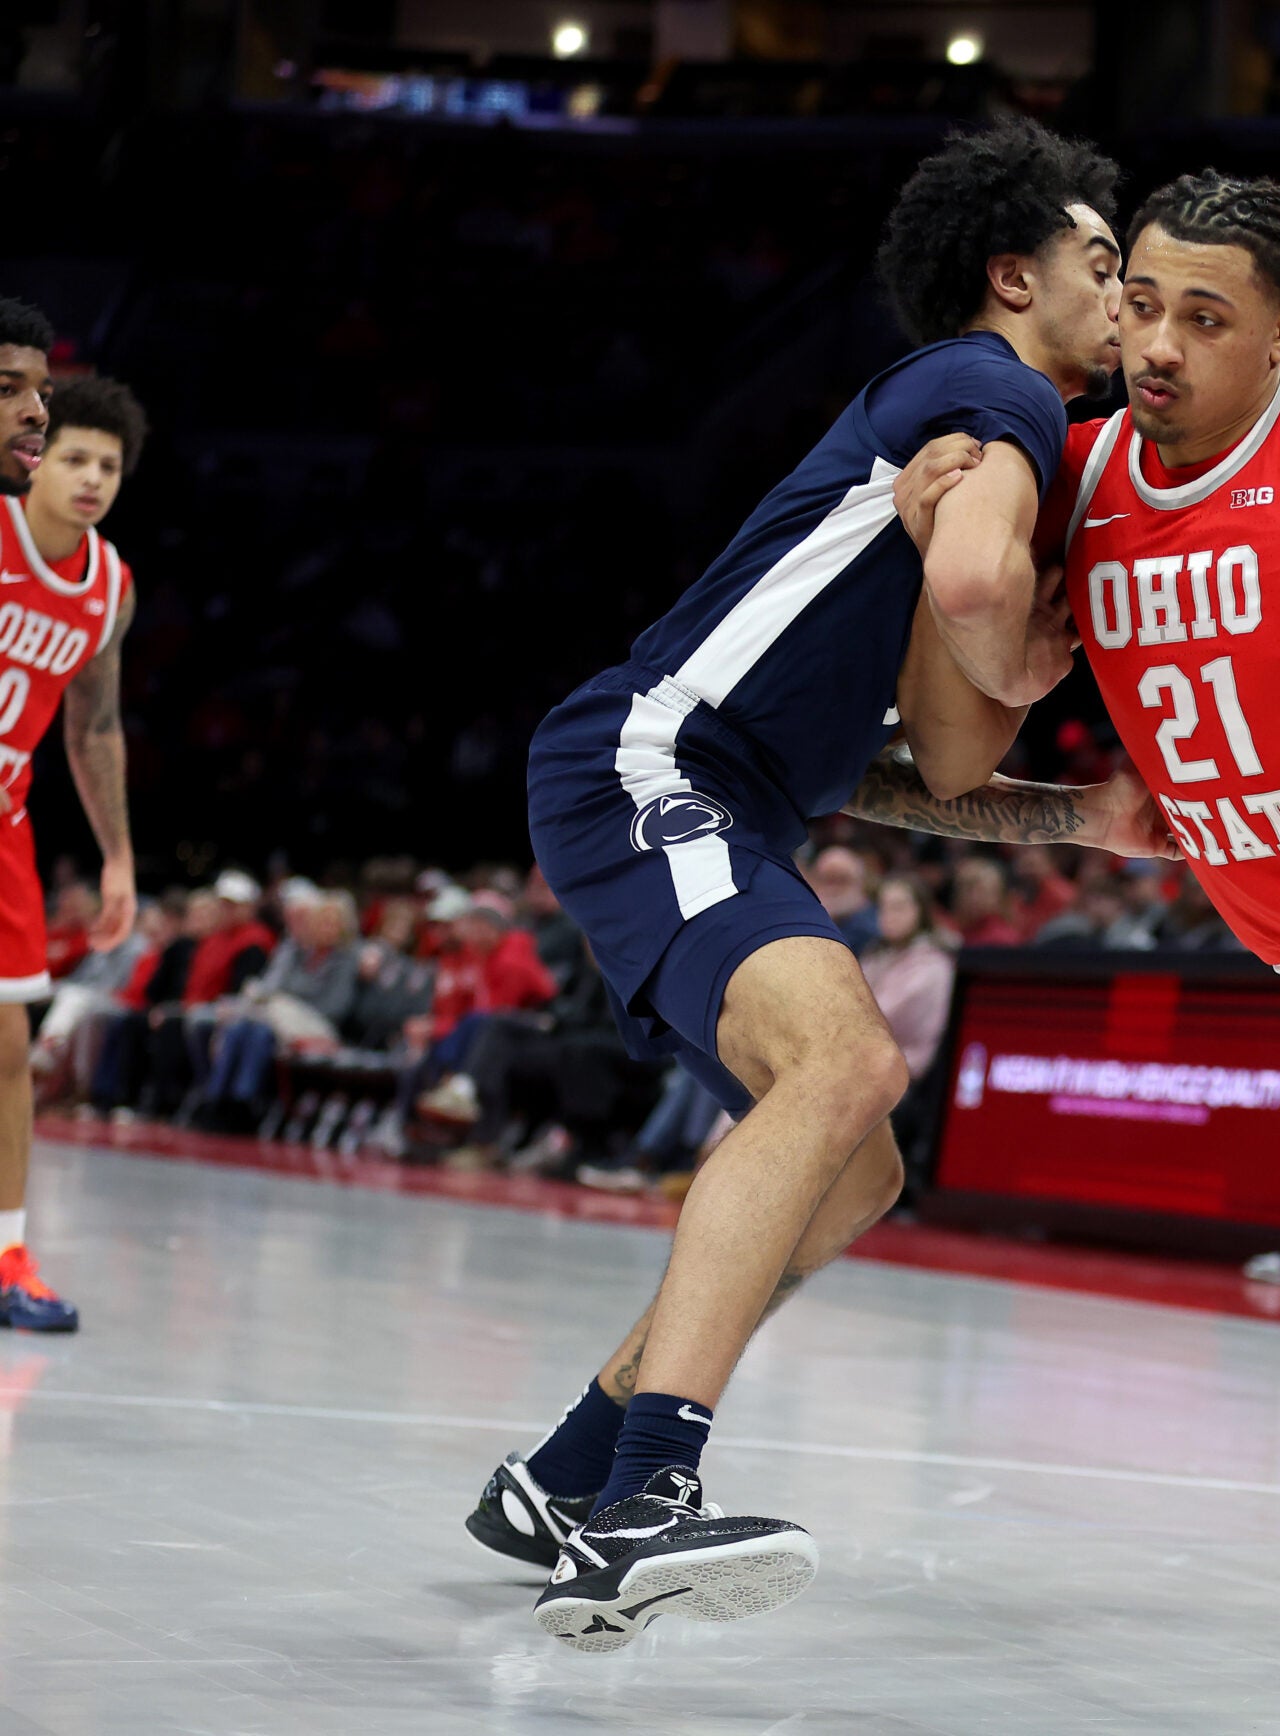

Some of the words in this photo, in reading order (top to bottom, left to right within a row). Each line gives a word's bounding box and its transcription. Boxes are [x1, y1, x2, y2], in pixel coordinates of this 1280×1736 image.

[0, 602, 89, 676] OHIO
[1088, 543, 1263, 650] OHIO
[1137, 656, 1264, 784] 21
